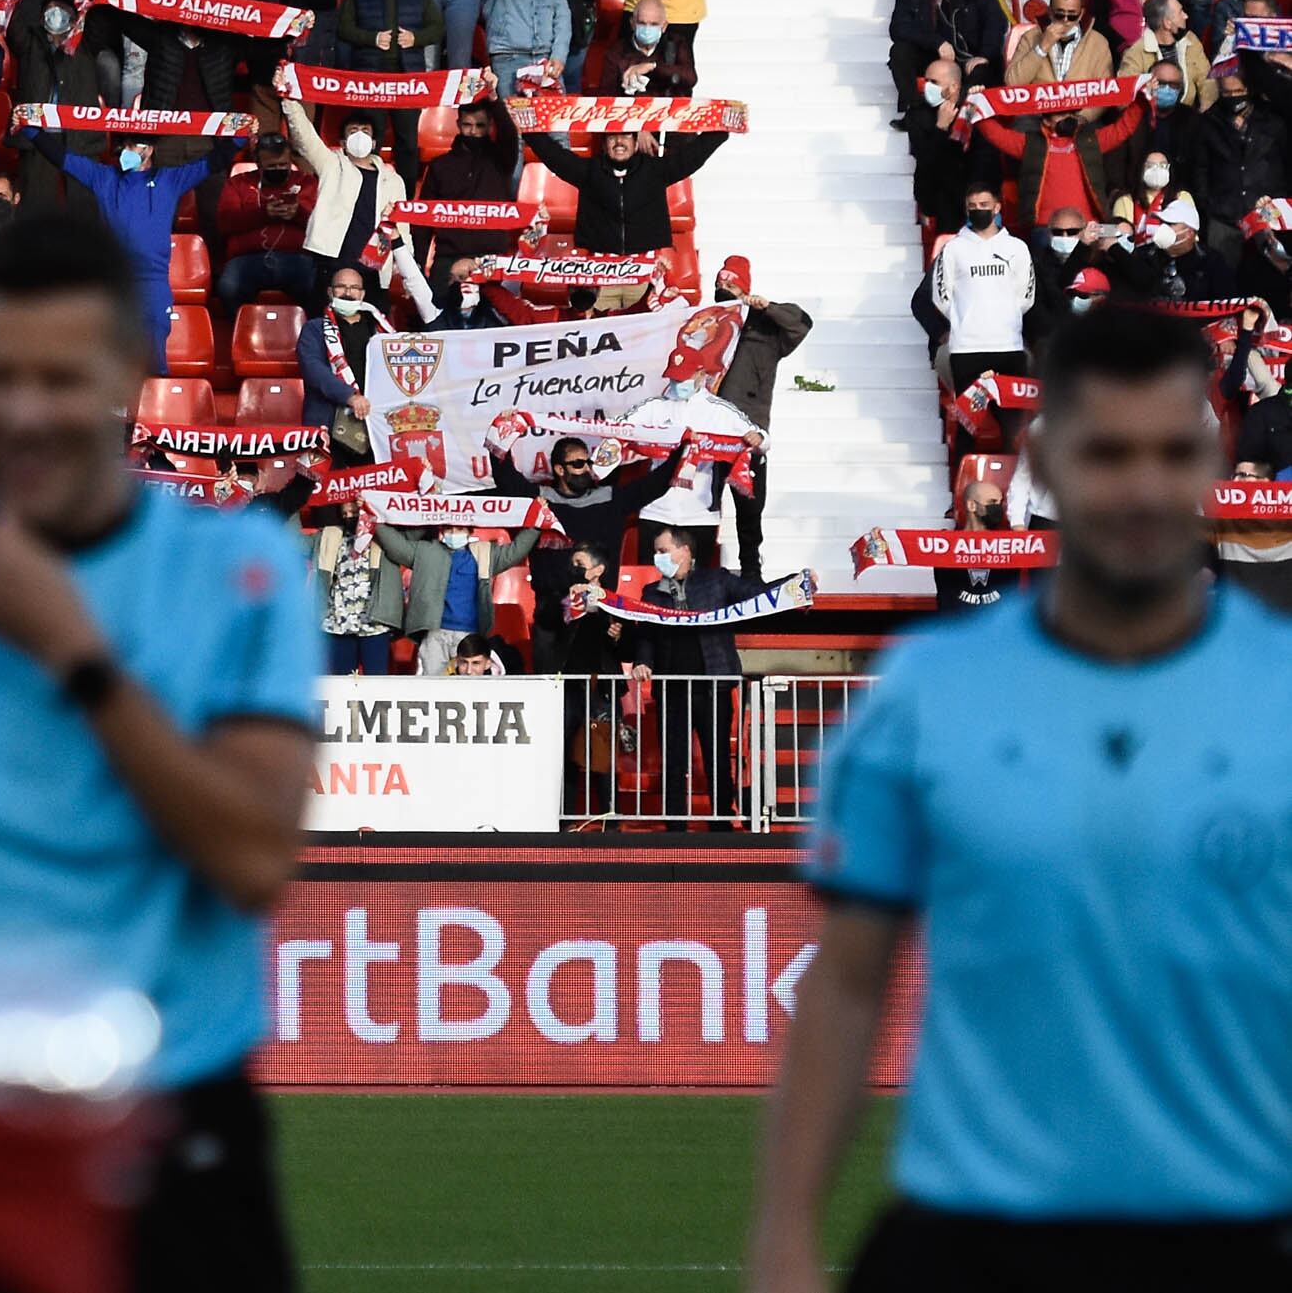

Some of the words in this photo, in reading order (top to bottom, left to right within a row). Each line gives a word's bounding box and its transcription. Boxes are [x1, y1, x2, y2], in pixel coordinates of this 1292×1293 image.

[312, 77, 339, 91] UD
[343, 79, 429, 96] ALMERÍA
[970, 265, 1005, 277] PUMA
[493, 330, 624, 367] PEÑA
[470, 378, 501, 407] La
[918, 537, 949, 552] UD
[954, 535, 1045, 554] ALMERÍA
[956, 554, 1011, 563] 2001-2021
